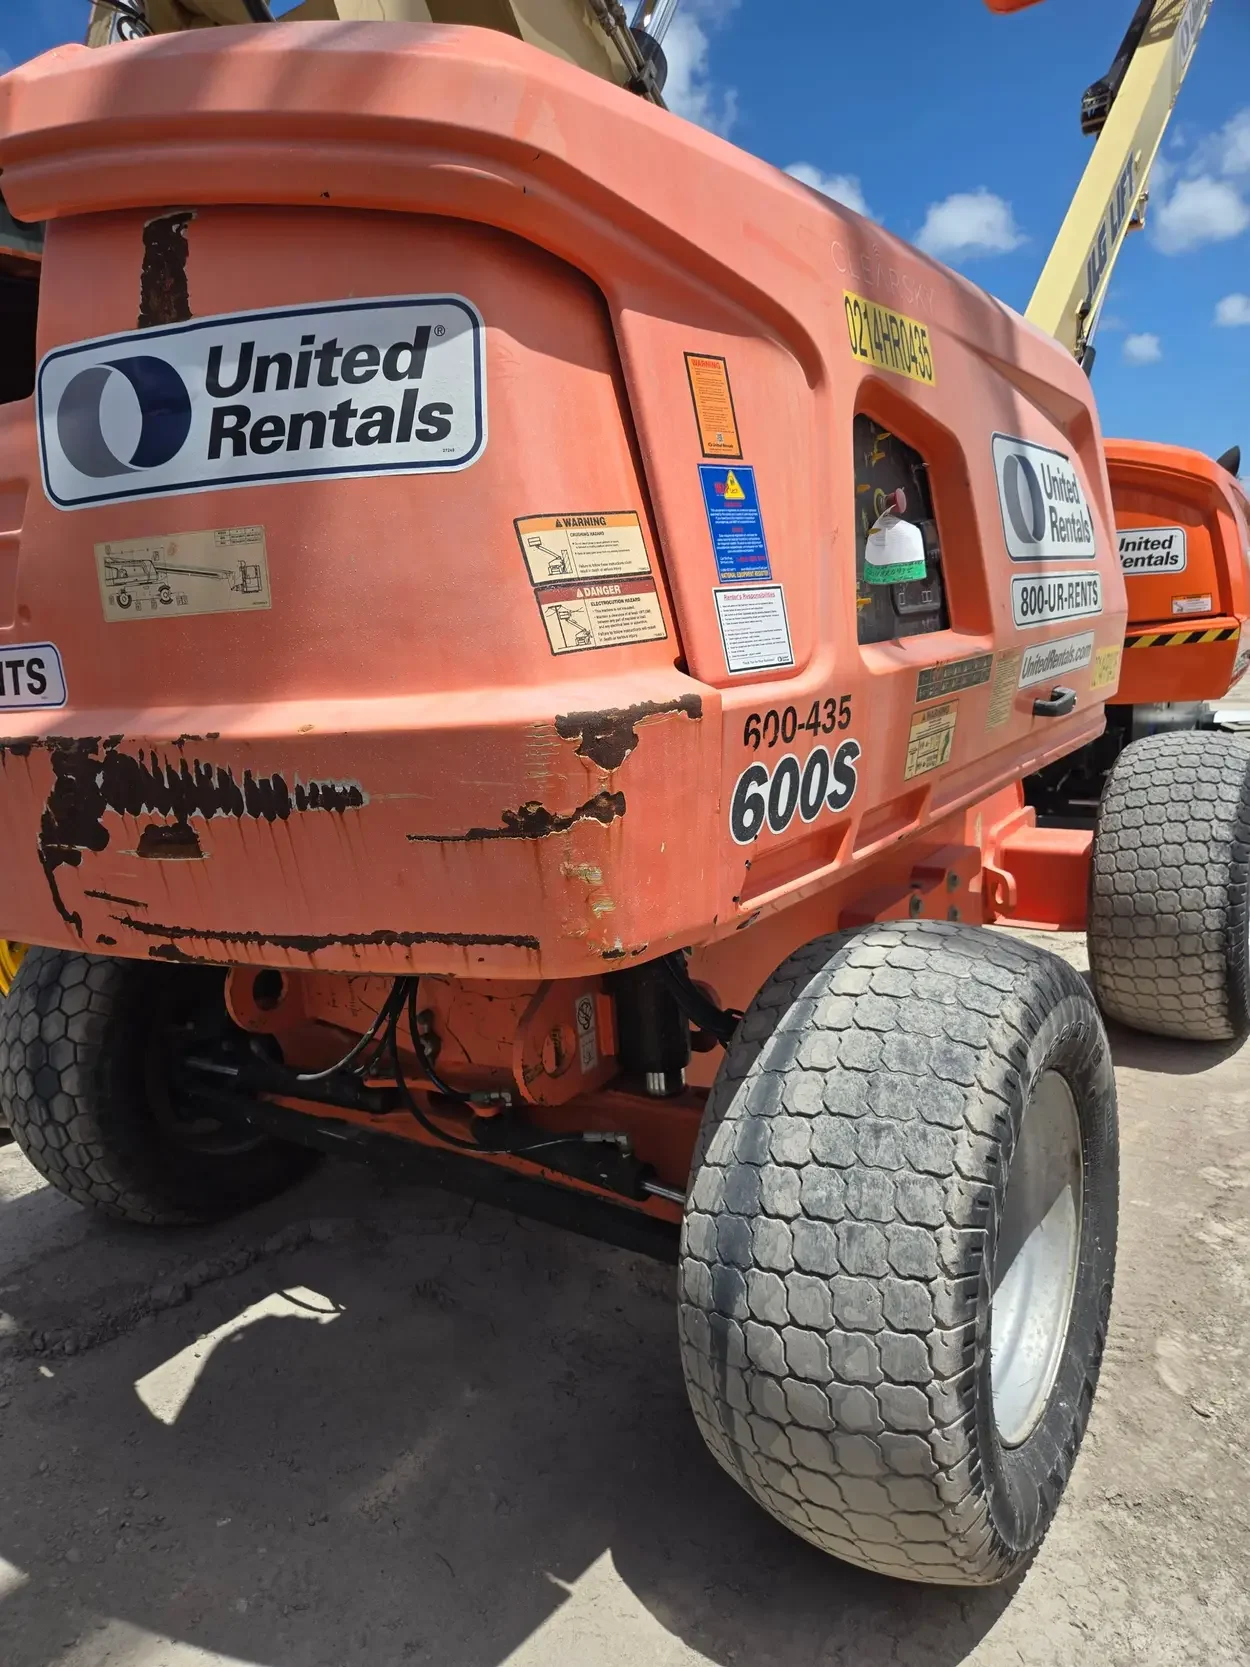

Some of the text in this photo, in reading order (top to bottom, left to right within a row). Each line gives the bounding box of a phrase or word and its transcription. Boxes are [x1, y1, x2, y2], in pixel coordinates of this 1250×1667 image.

[1087, 151, 1134, 298] JLG LIFT
[844, 295, 933, 381] 0214HR0435
[205, 324, 432, 398] United
[207, 388, 454, 461] Rentals
[1041, 462, 1080, 504] United
[563, 516, 607, 528] WARNING
[1048, 505, 1091, 543] Rentals
[1120, 552, 1179, 568] entals
[584, 584, 621, 597] DANGER
[1020, 582, 1098, 617] 800-UR-RENTS
[0, 658, 47, 696] TS
[1021, 644, 1092, 680] UnitedRentals.com
[743, 694, 852, 751] 600-435
[730, 738, 861, 844] 600S
